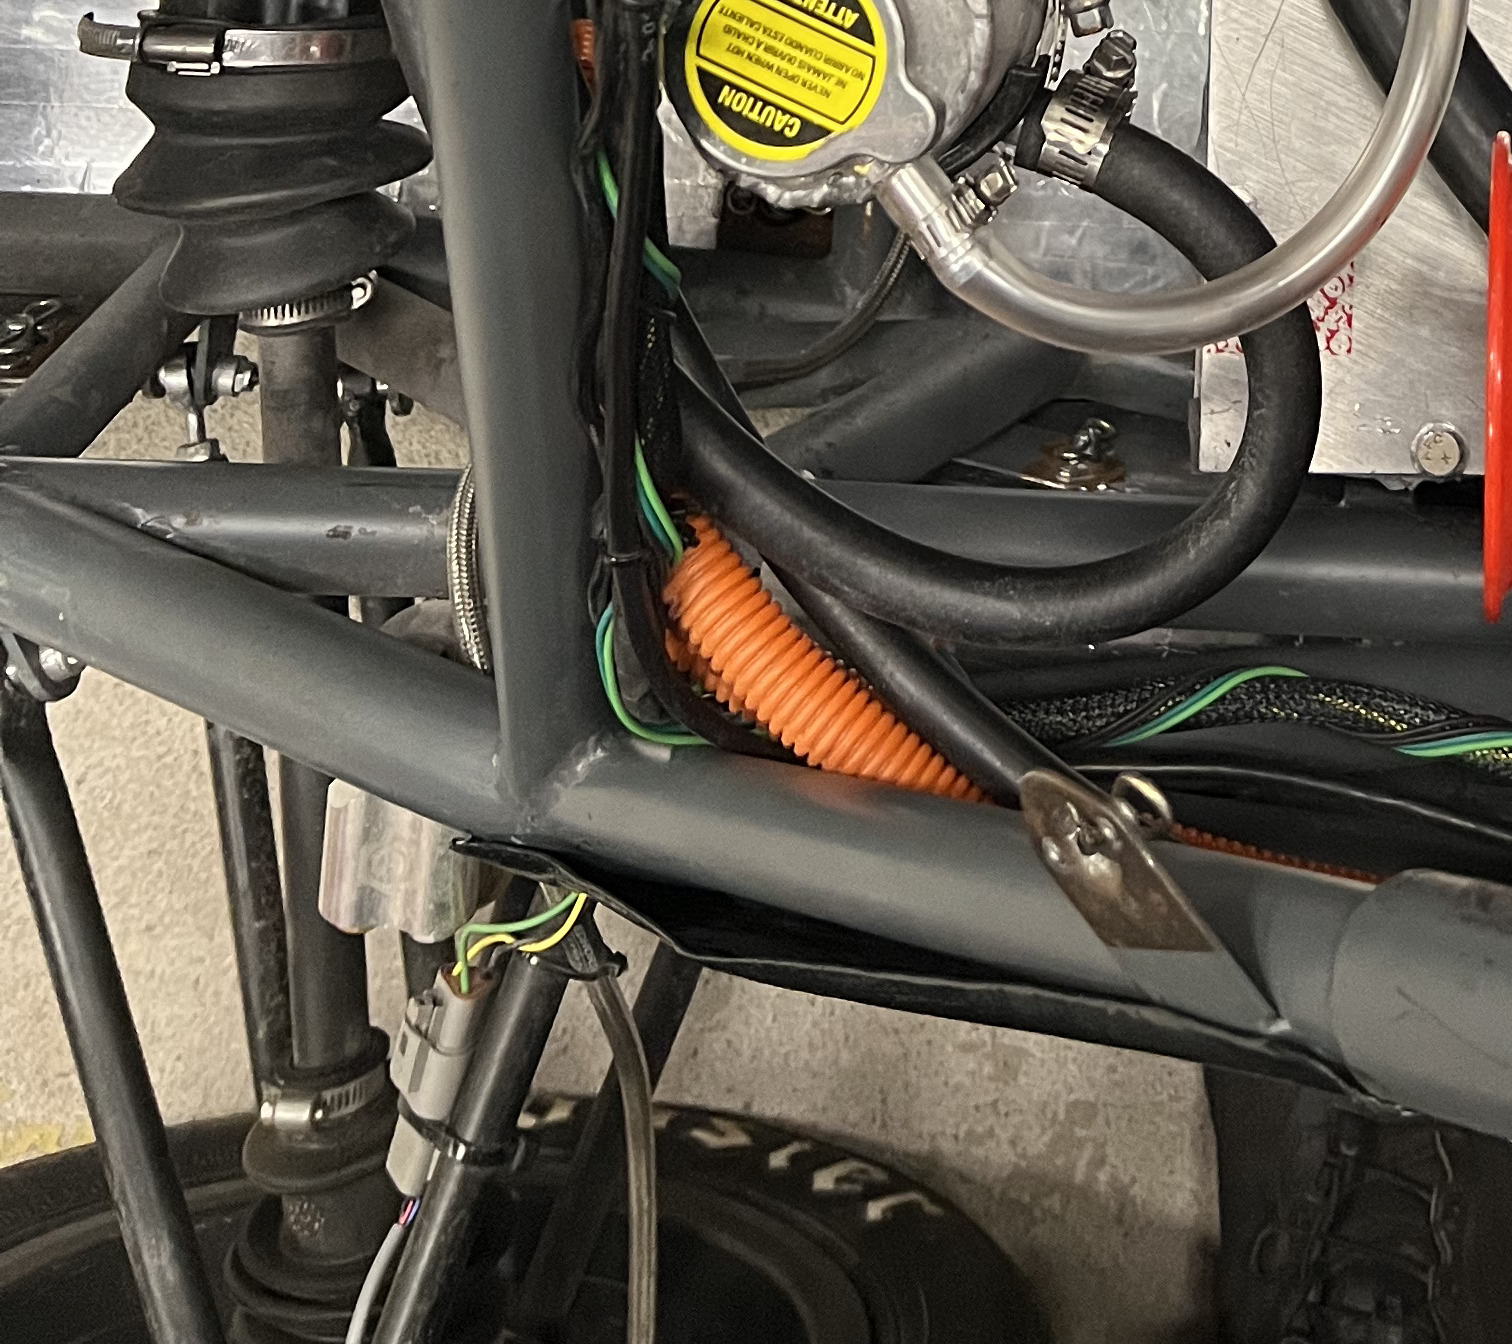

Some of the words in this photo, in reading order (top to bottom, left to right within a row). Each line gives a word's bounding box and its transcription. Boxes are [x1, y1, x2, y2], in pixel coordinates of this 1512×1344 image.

[718, 4, 762, 32] CALIENTE
[722, 23, 756, 46] CHAUD
[726, 42, 746, 58] HOT
[763, 43, 797, 65] OUVRIR
[783, 36, 824, 61] CUANDO
[745, 52, 775, 72] WHEN
[797, 59, 834, 83] JAMAIS
[823, 54, 852, 74] ABRIR
[774, 65, 800, 84] OPEN
[834, 77, 848, 89] NE
[851, 68, 866, 81] NO
[798, 77, 832, 99] NEVER
[717, 85, 802, 139] CAUTION
